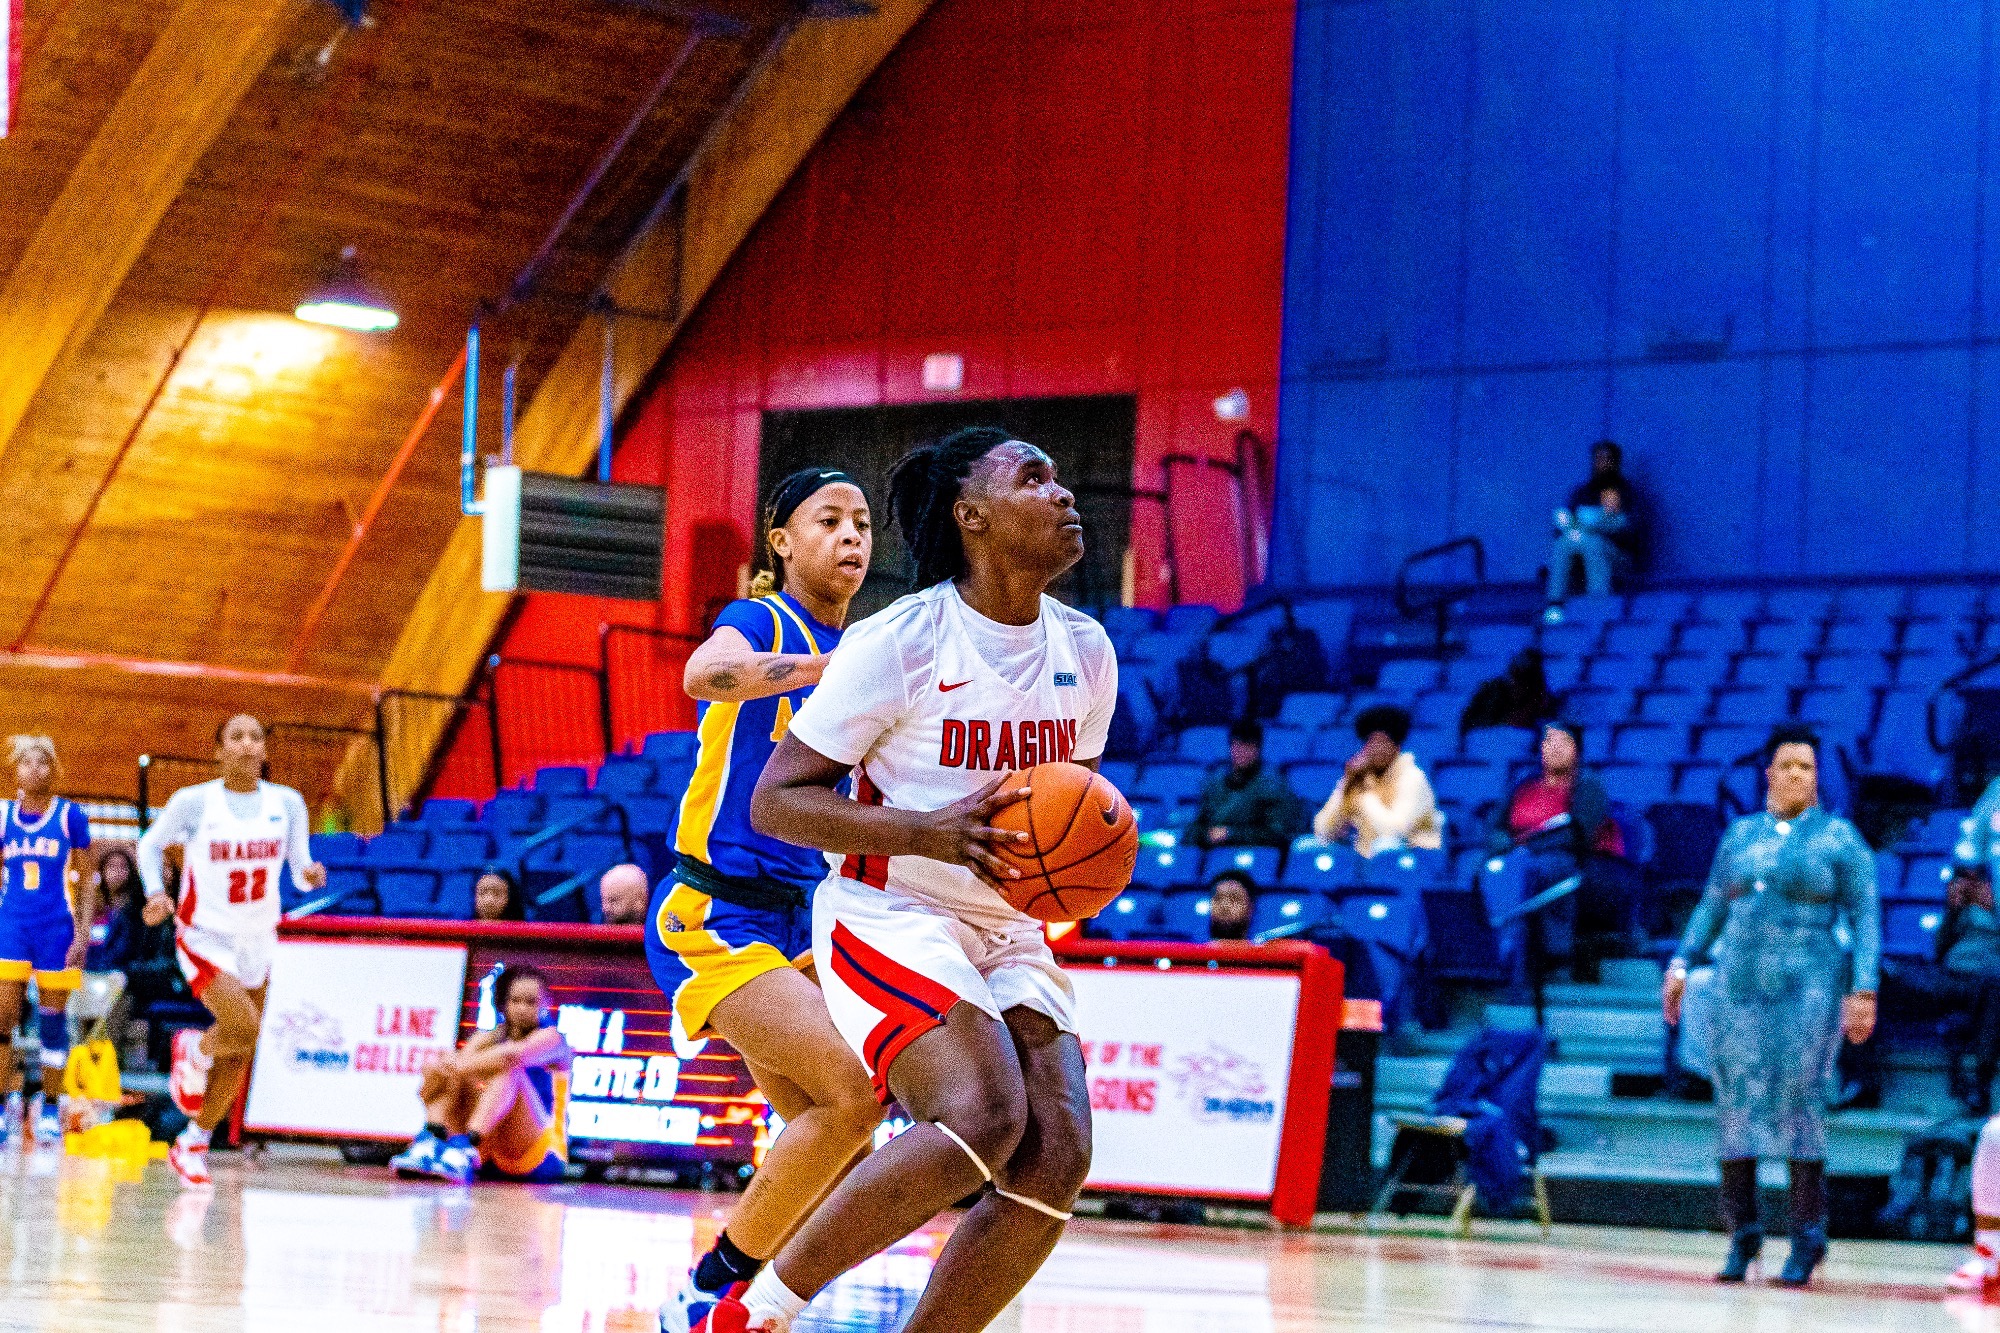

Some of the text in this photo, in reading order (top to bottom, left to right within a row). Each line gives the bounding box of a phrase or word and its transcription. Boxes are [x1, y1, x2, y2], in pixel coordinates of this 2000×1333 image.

[228, 867, 268, 905] 22
[374, 1003, 437, 1039] LANE
[354, 1042, 449, 1076] COLLE
